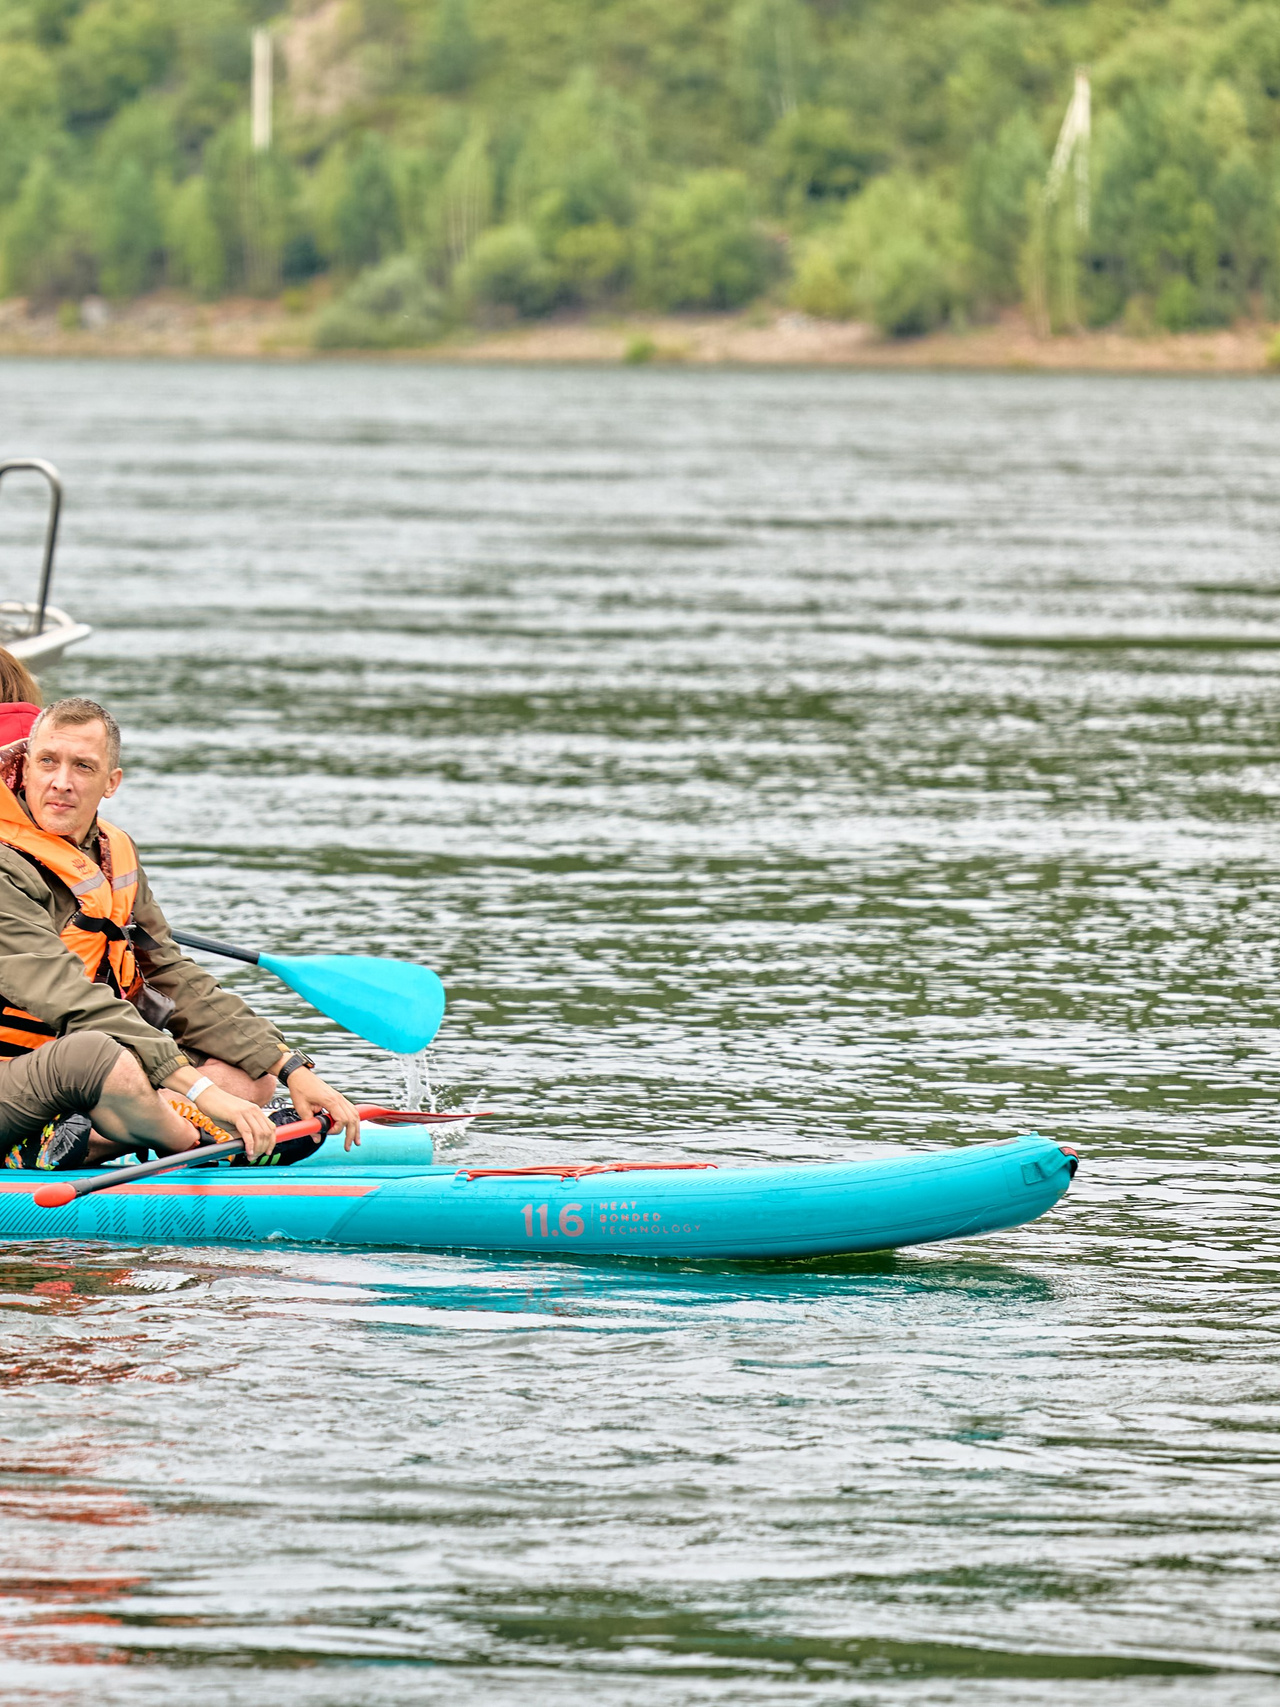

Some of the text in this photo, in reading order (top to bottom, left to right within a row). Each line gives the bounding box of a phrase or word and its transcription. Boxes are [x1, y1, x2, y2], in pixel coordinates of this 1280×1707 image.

[599, 1201, 637, 1211] HEAT
[520, 1203, 585, 1238] 11.6
[599, 1212, 661, 1223] BONDED
[601, 1224, 701, 1236] TECHNOLOGY
